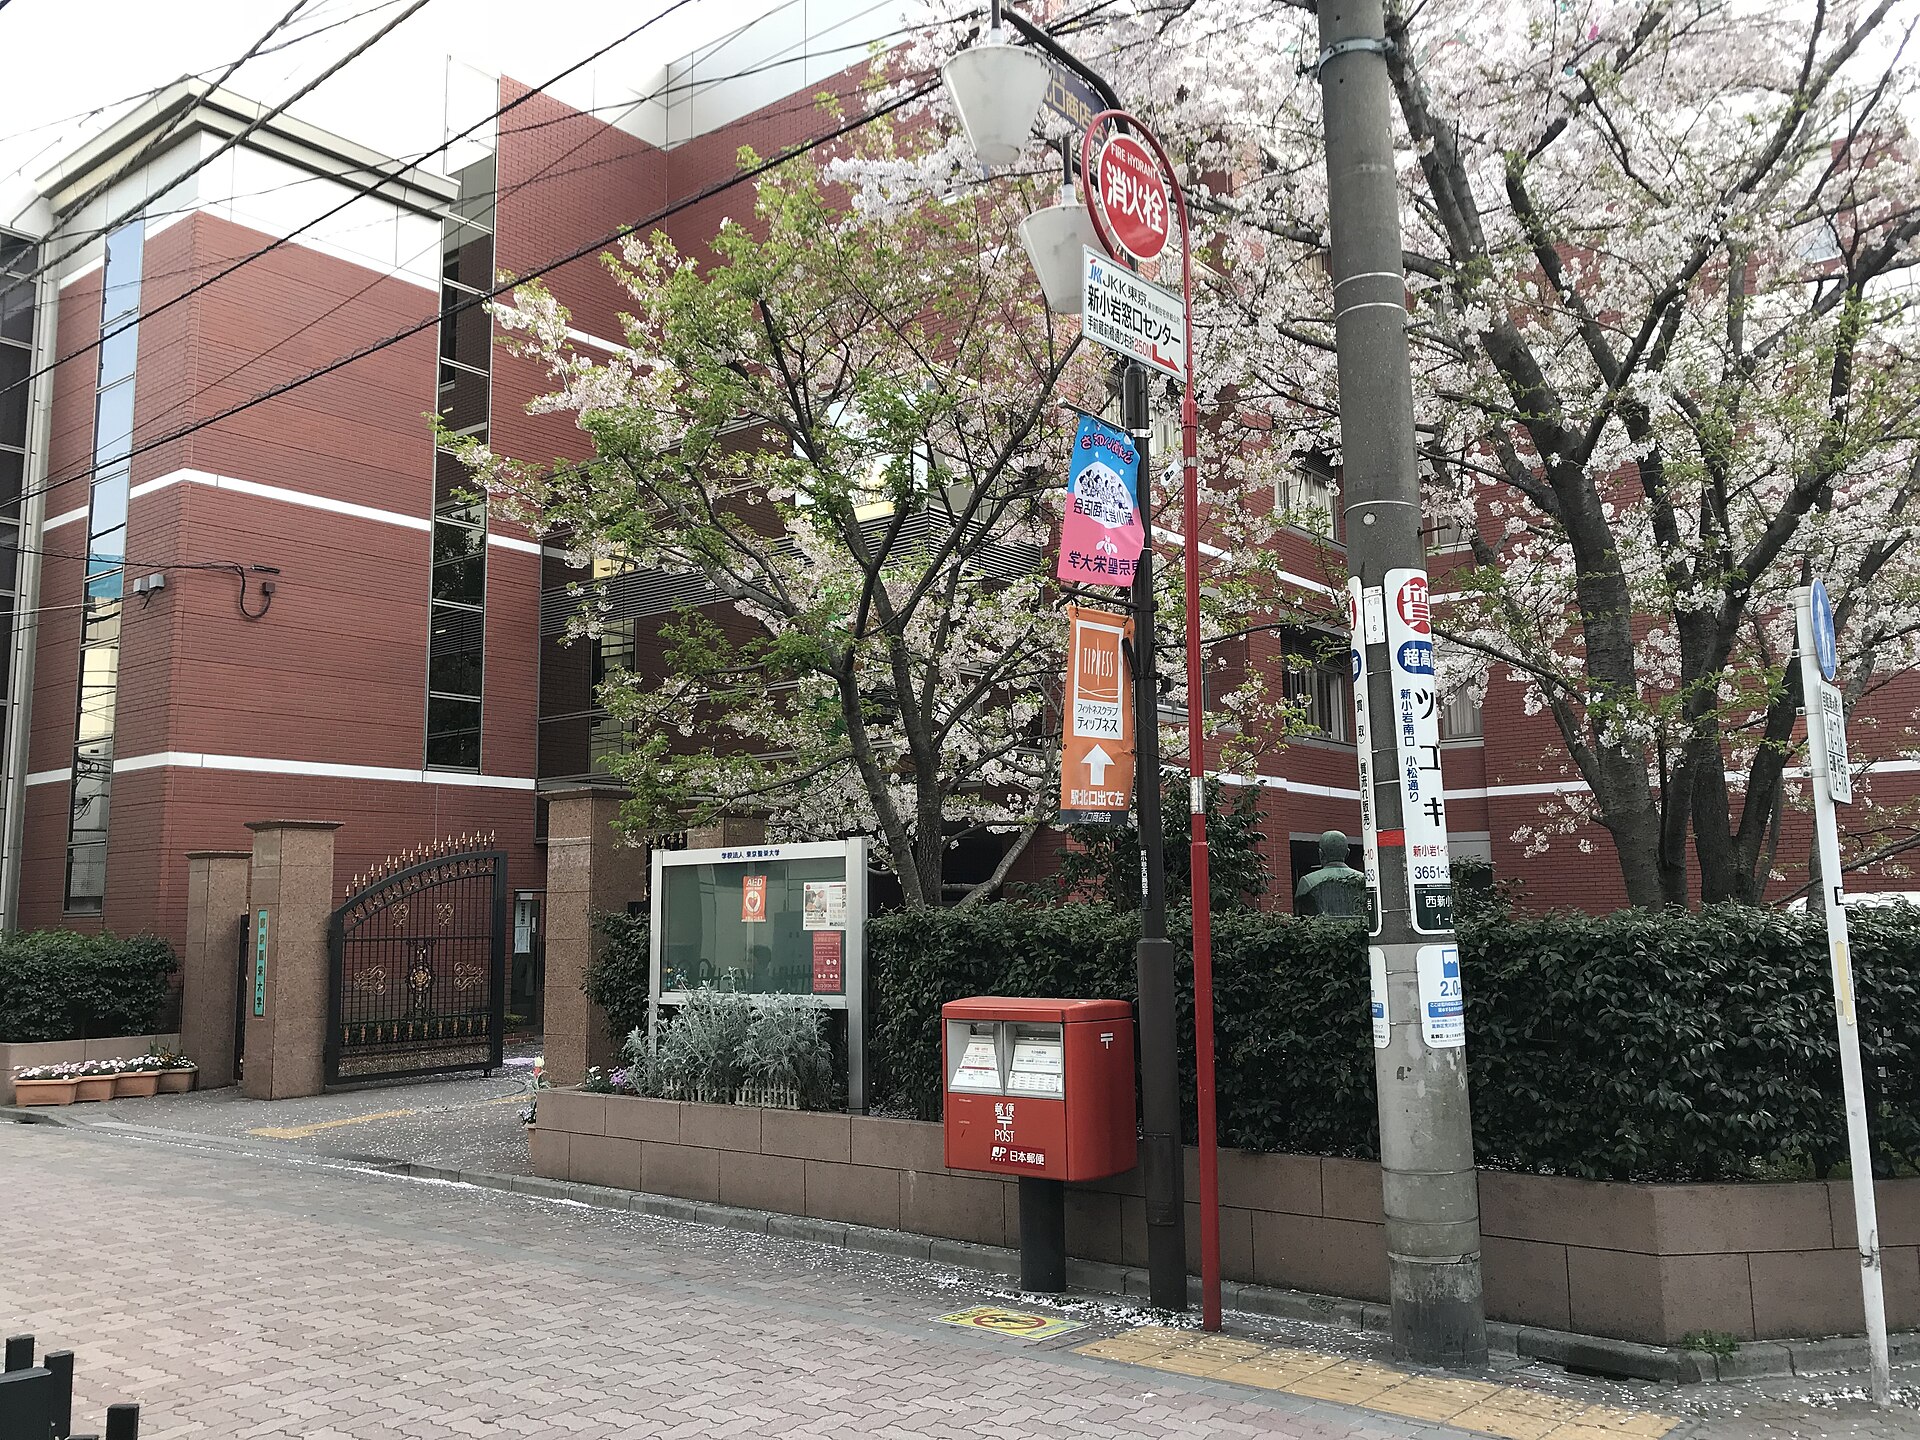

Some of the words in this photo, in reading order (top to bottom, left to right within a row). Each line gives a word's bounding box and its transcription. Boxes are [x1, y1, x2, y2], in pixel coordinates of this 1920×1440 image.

[1111, 143, 1125, 162] FIRE
[1127, 152, 1157, 181] HYDRANT
[1106, 160, 1164, 235] 消火栓
[1088, 284, 1181, 346] 新小岩窓口センター
[1083, 640, 1114, 684] TIPNESS
[1403, 647, 1434, 668] 超高
[1077, 703, 1118, 717] フィットネスクラブ
[1400, 689, 1415, 747] 新小岩南口
[1077, 716, 1118, 733] ティップネス
[1405, 755, 1419, 803] 小松通り
[1071, 789, 1124, 807] 駅北口出て左
[1079, 811, 1112, 823] 北口商店会
[746, 878, 763, 887] AED
[994, 1102, 1015, 1118] 郵便
[994, 1129, 1015, 1143] POST
[1010, 1150, 1045, 1166] 日本郵便
